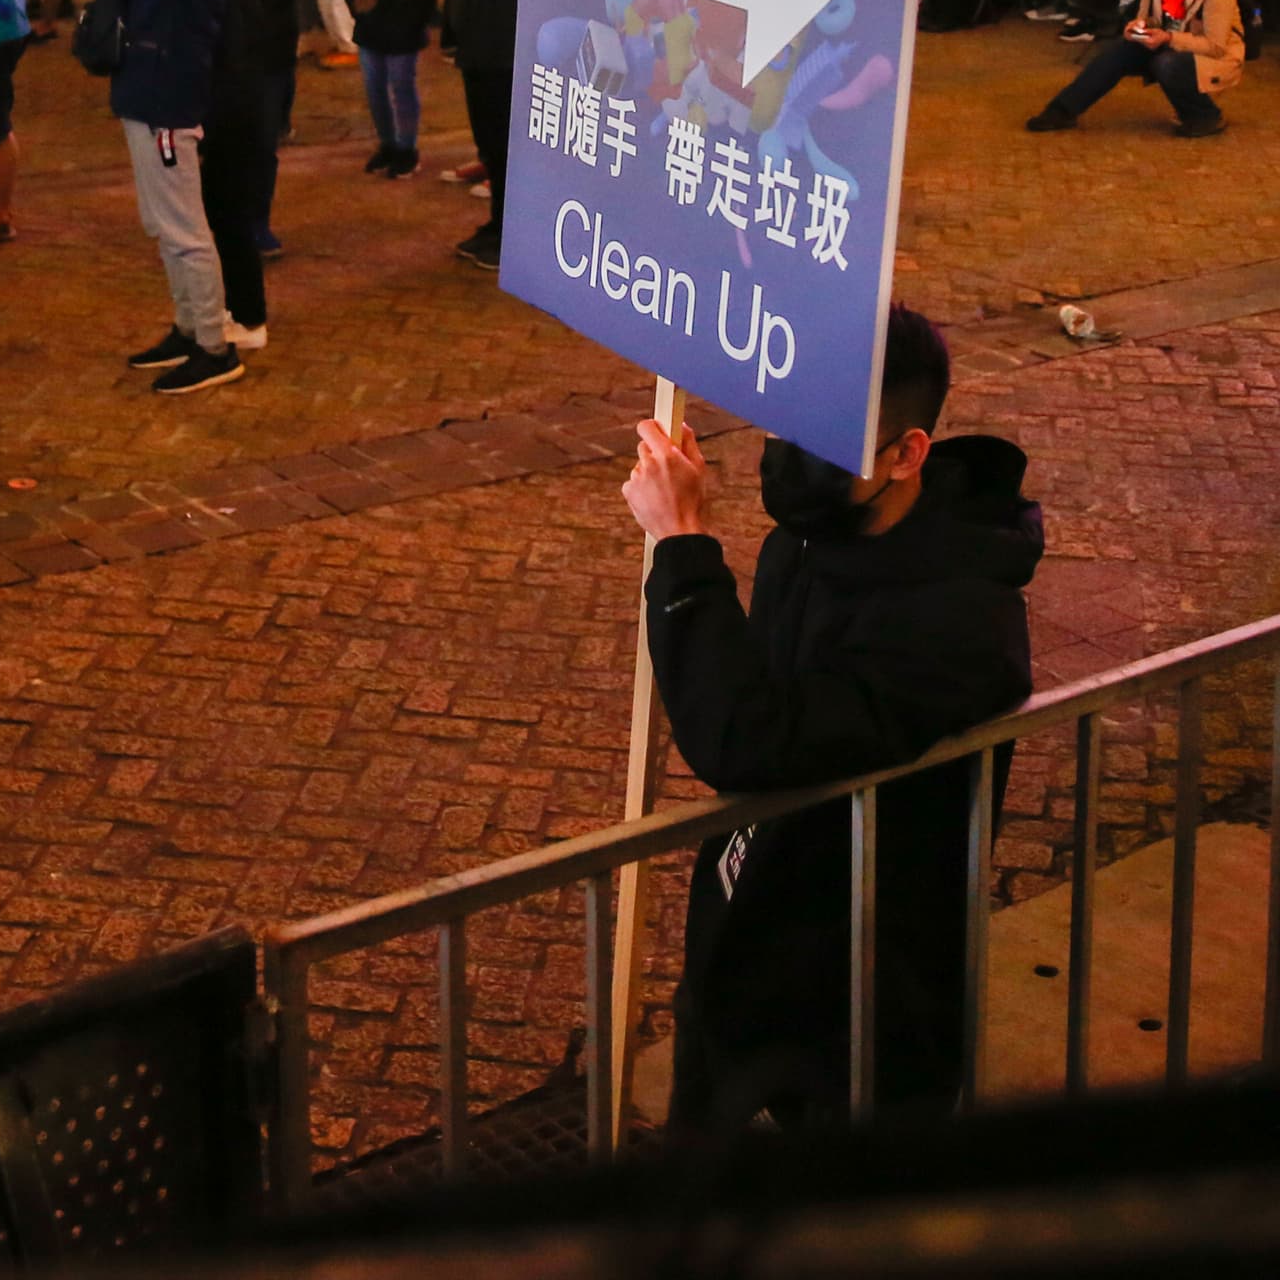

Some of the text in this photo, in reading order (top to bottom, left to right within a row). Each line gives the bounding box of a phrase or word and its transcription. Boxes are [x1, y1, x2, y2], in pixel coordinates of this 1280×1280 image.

[528, 63, 851, 271] 請隨手 帶走垃圾
[553, 199, 796, 394] Clean Up
